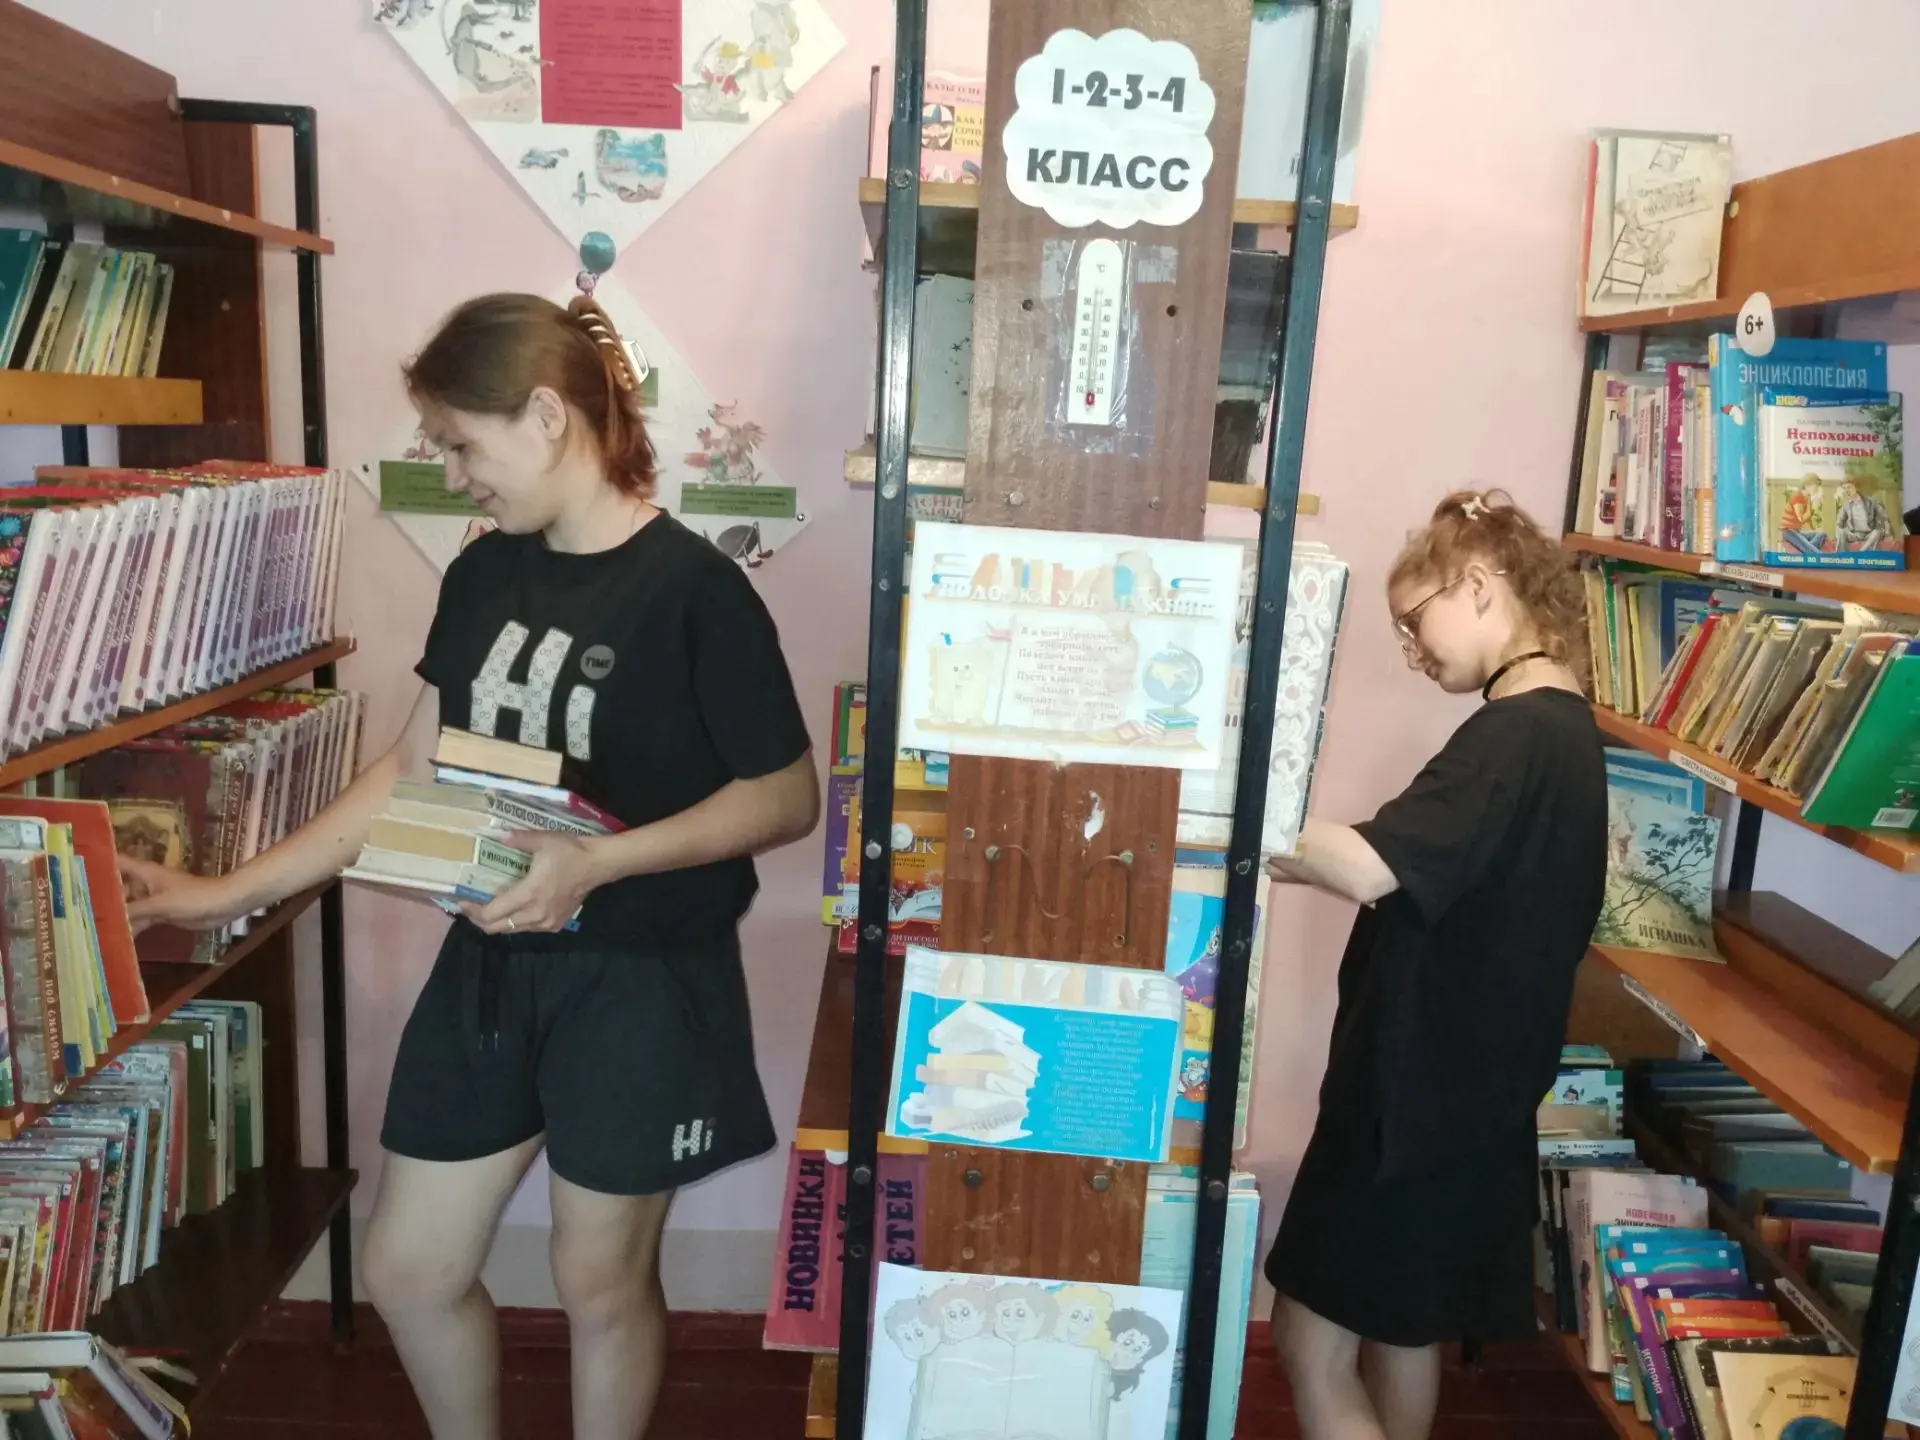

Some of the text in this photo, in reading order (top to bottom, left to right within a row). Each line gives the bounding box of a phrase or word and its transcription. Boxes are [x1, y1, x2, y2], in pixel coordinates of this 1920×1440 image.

[1052, 68, 1186, 112] 1-2-3-4
[1027, 147, 1190, 192] КЛАСС
[1745, 315, 1763, 335] 6+
[1739, 363, 1867, 389] ЭНЦИКЛОПЕДИЯ
[1787, 428, 1880, 443] Непохожие
[1792, 442, 1874, 457] близнецы
[586, 656, 612, 669] TIME
[469, 619, 615, 762] Hi
[37, 877, 52, 971] Земляника
[45, 979, 57, 1004] под
[672, 1117, 716, 1161] Hi
[784, 1157, 826, 1312] НОВИНКИ
[877, 1179, 916, 1264] ЕТЕЙ
[1641, 1347, 1663, 1395] ИСТОРИЯ
